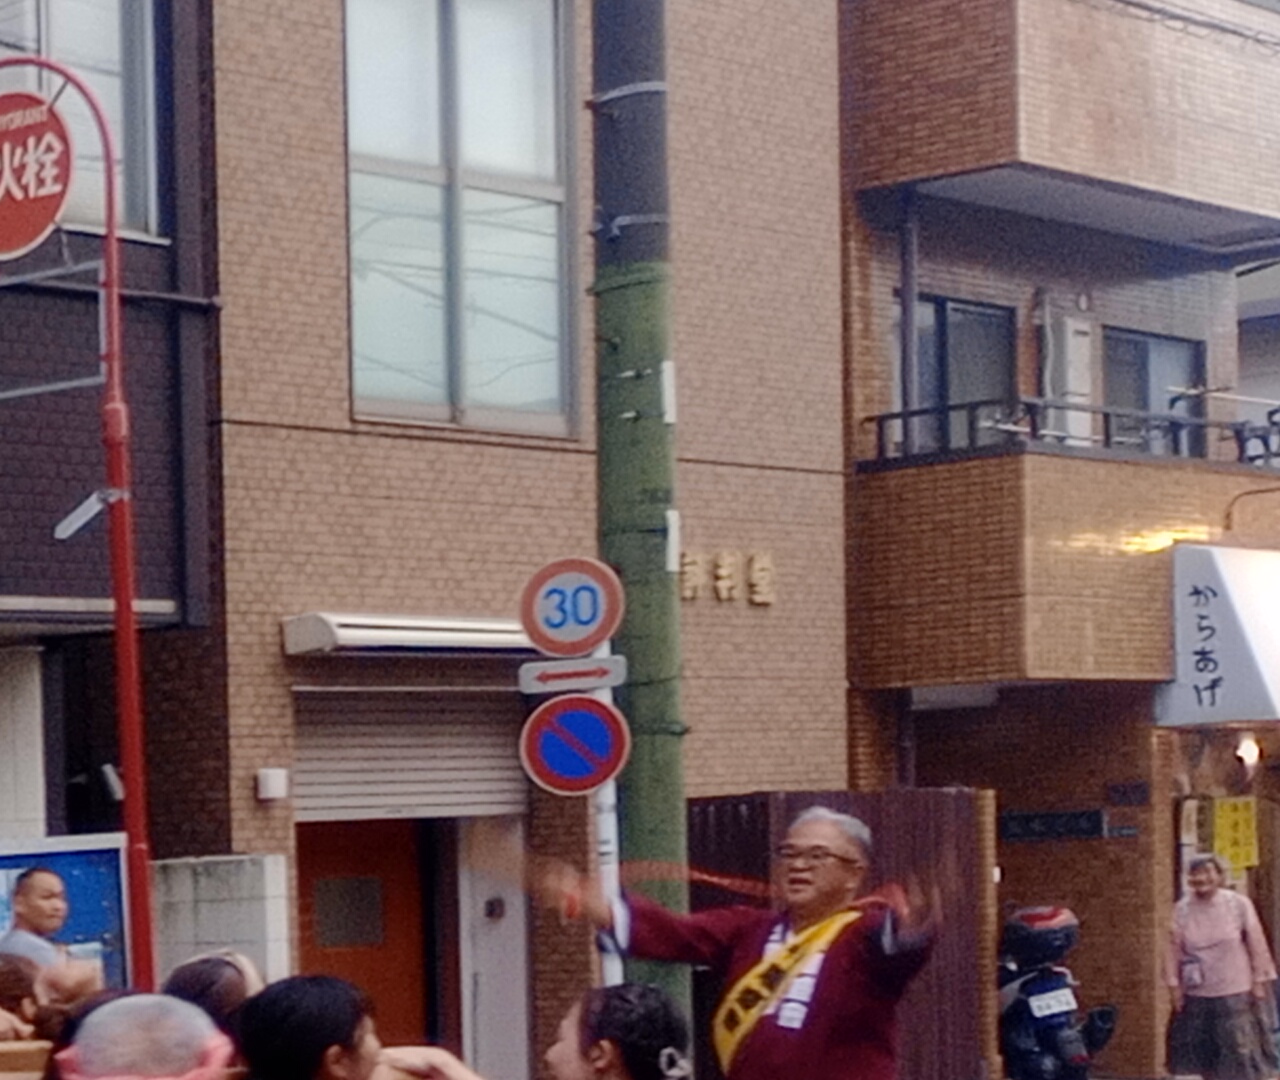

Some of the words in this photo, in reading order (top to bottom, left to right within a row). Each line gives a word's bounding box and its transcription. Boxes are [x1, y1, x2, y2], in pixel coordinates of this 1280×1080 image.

[543, 585, 599, 630] 30
[1188, 584, 1224, 708] からあげ
